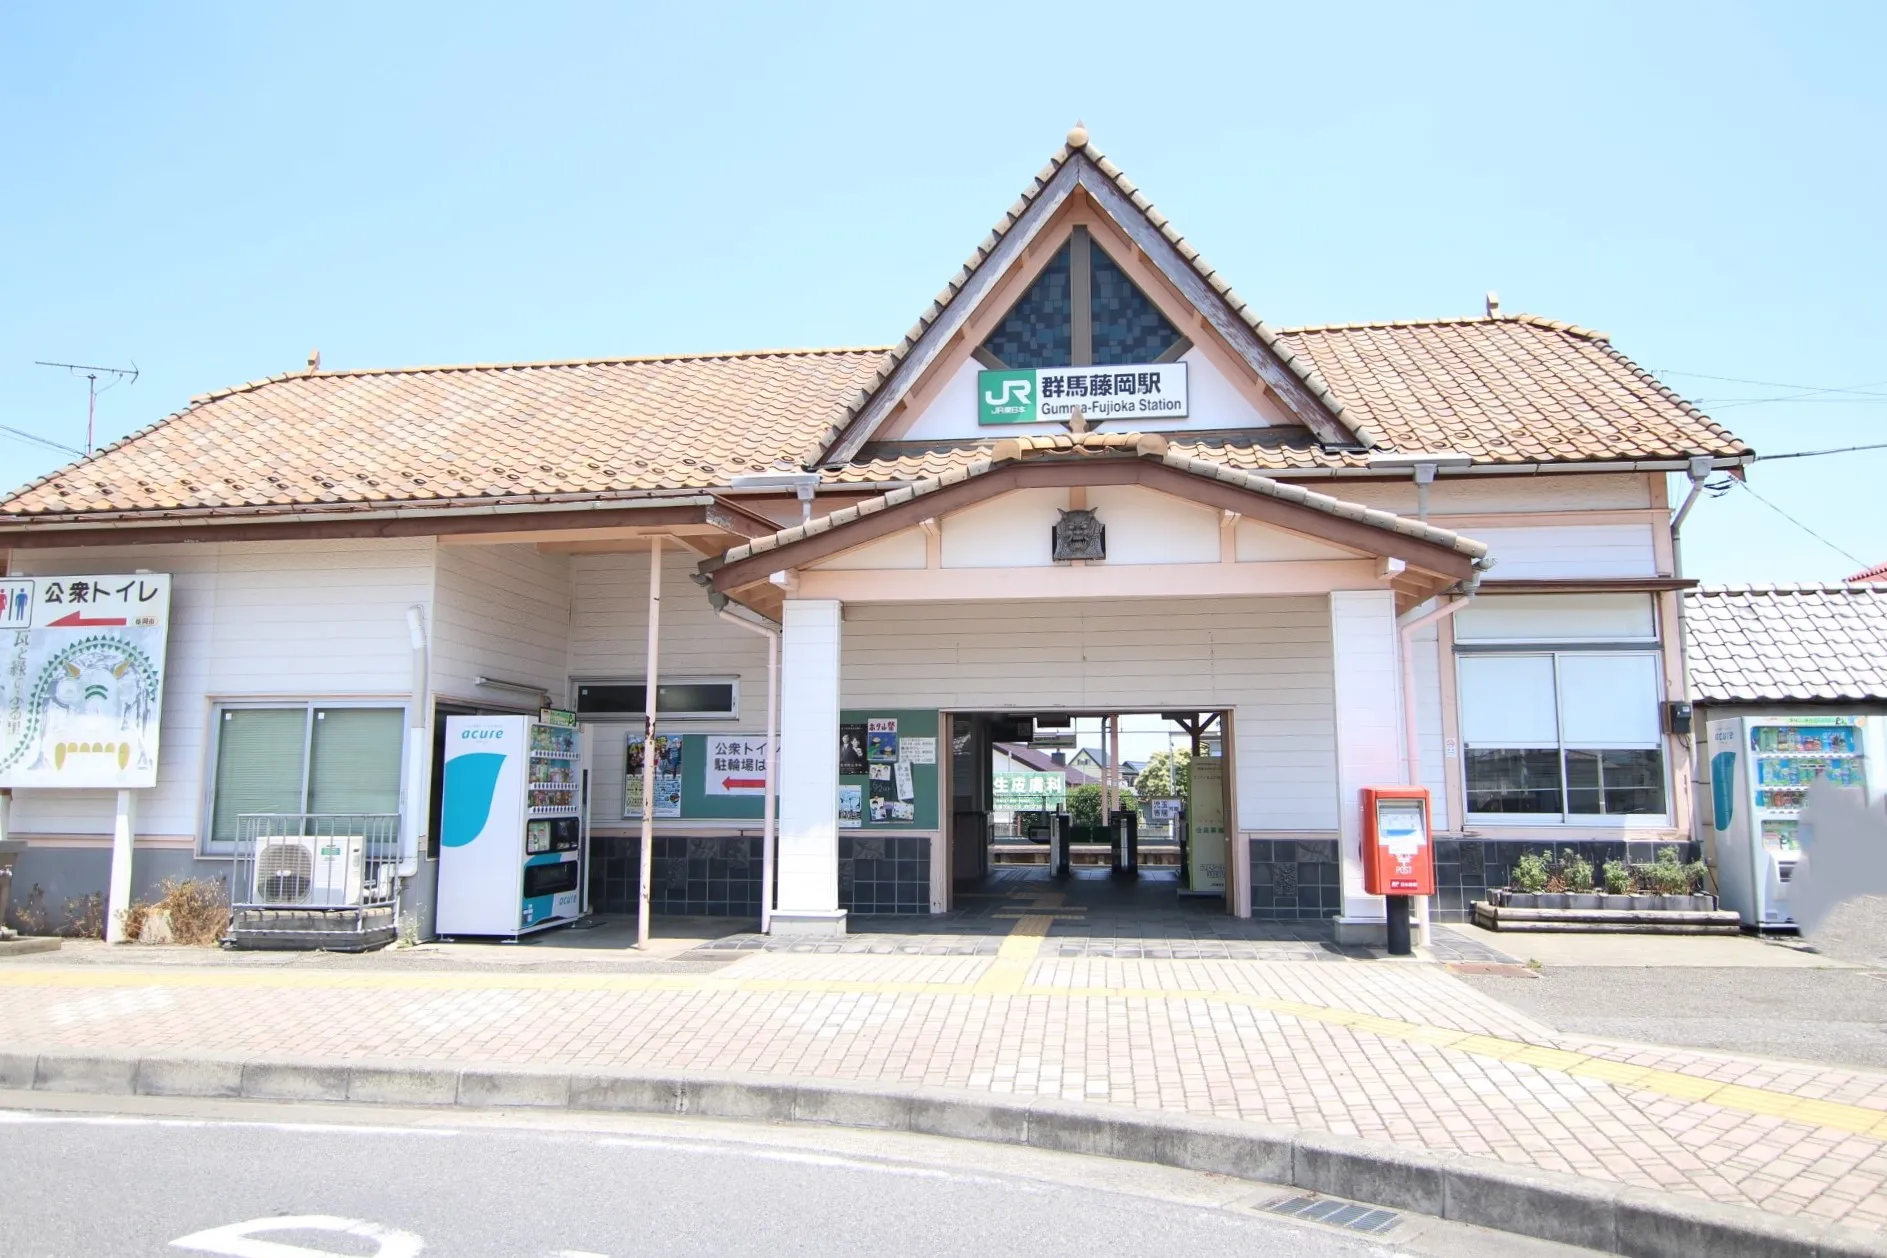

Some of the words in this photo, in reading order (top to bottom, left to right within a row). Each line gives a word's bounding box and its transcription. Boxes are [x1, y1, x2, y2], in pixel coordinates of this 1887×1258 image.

[1042, 372, 1161, 398] 群馬藤岡駅
[985, 379, 1031, 405] JR
[1140, 399, 1181, 412] Station
[45, 580, 158, 604] 公衆トイレ
[868, 721, 896, 731] ホタル祭
[461, 730, 504, 739] acure
[715, 742, 780, 755] 公衆トイ
[714, 758, 766, 771] 駐輪場は
